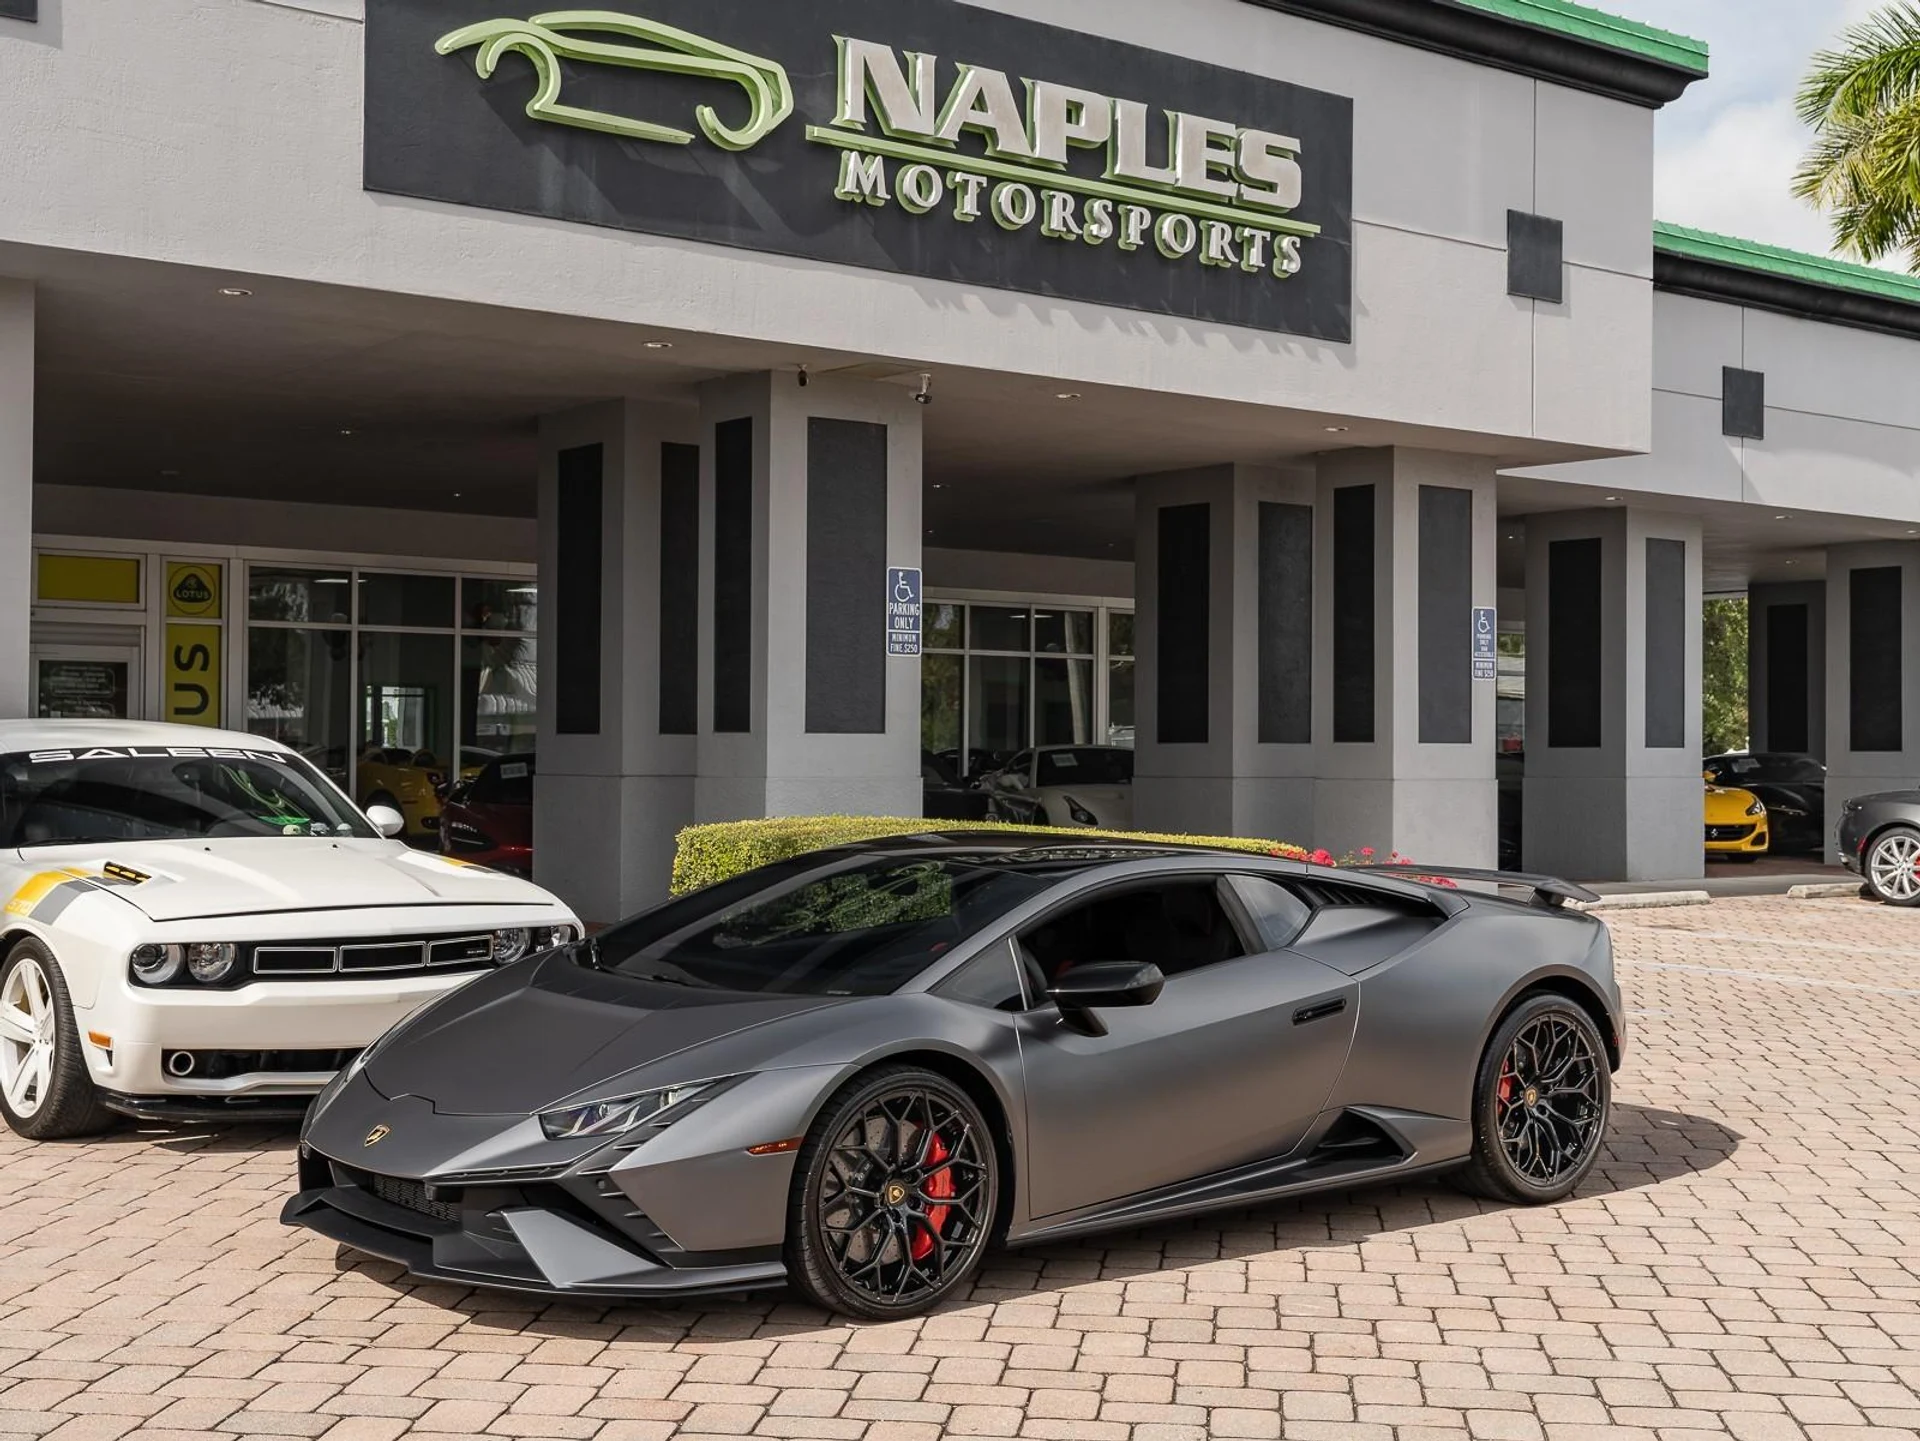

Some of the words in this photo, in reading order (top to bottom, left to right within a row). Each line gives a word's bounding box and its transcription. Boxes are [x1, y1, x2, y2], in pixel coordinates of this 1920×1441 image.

[831, 34, 1302, 213] NAPLES
[834, 150, 1302, 279] MOTORSPORTS
[175, 589, 210, 600] LOTUS
[889, 602, 920, 616] PARKING
[894, 616, 914, 629] ONLY
[891, 633, 917, 642] MINIMUM
[890, 643, 903, 653] FINE
[903, 643, 918, 653] $250
[173, 643, 210, 716] US
[29, 747, 287, 764] SALEEN
